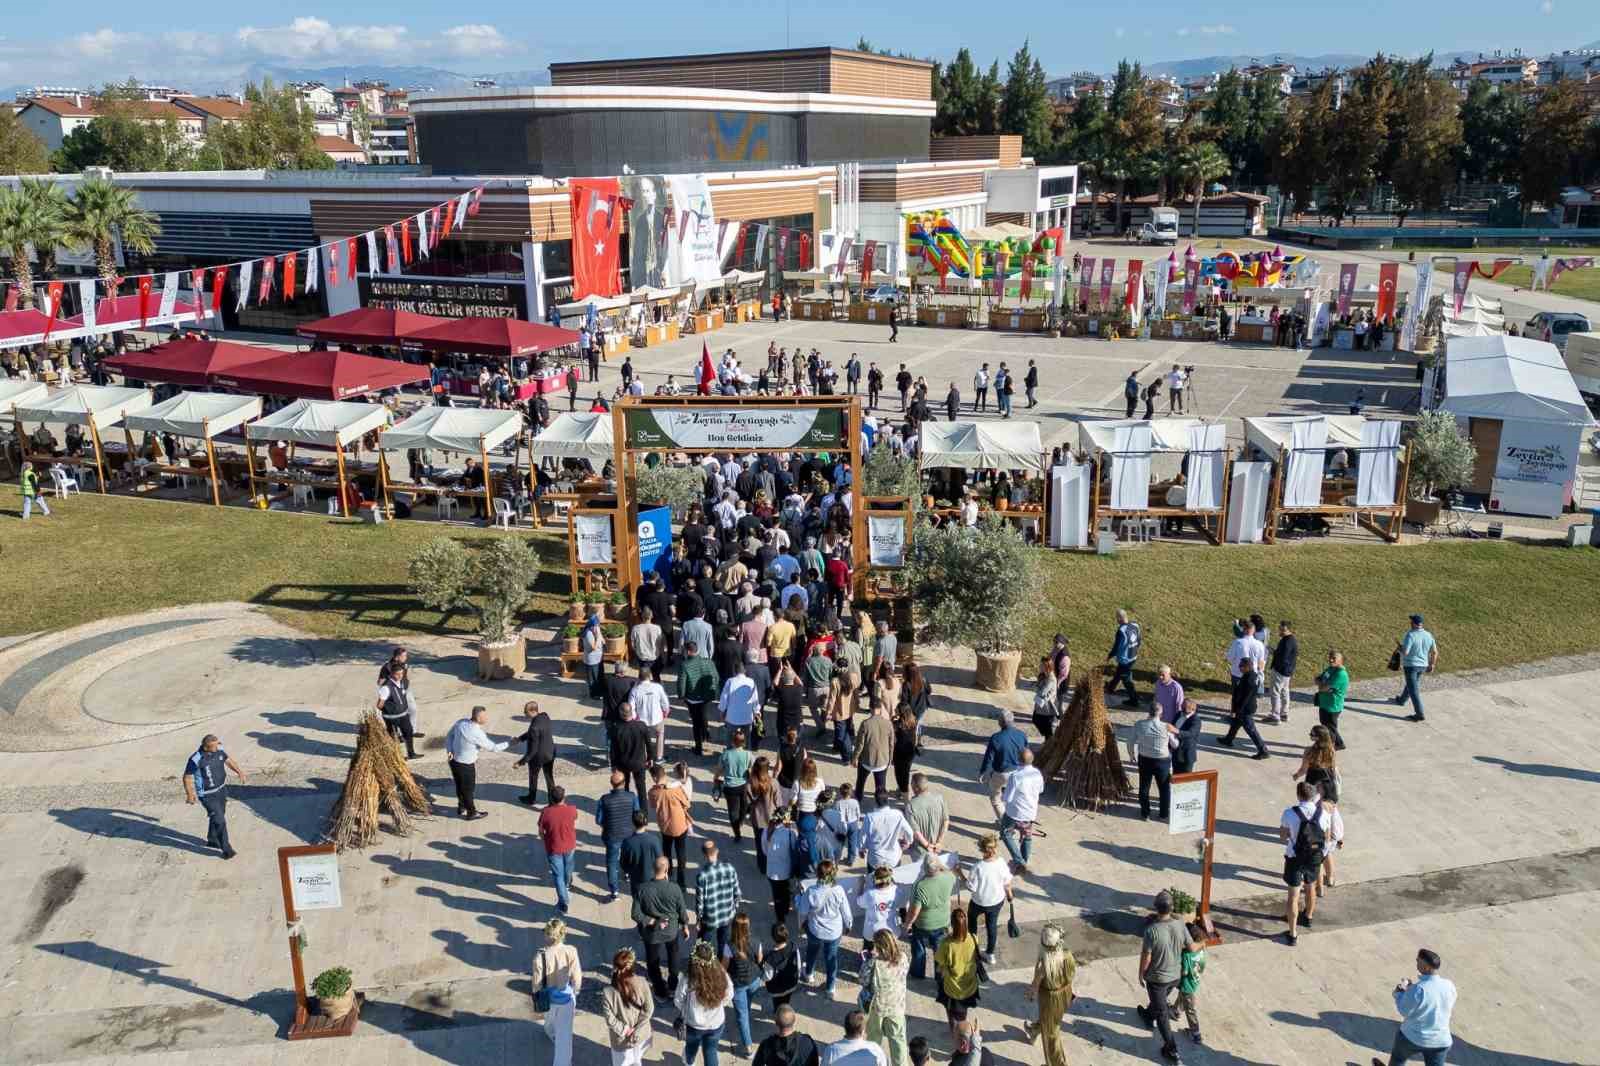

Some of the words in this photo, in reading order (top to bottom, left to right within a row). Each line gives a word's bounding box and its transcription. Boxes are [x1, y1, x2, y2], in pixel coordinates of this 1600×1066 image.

[417, 300, 464, 317] KÜLTÜR
[465, 303, 518, 320] MERKEZİ
[1506, 446, 1545, 463] Zeytin
